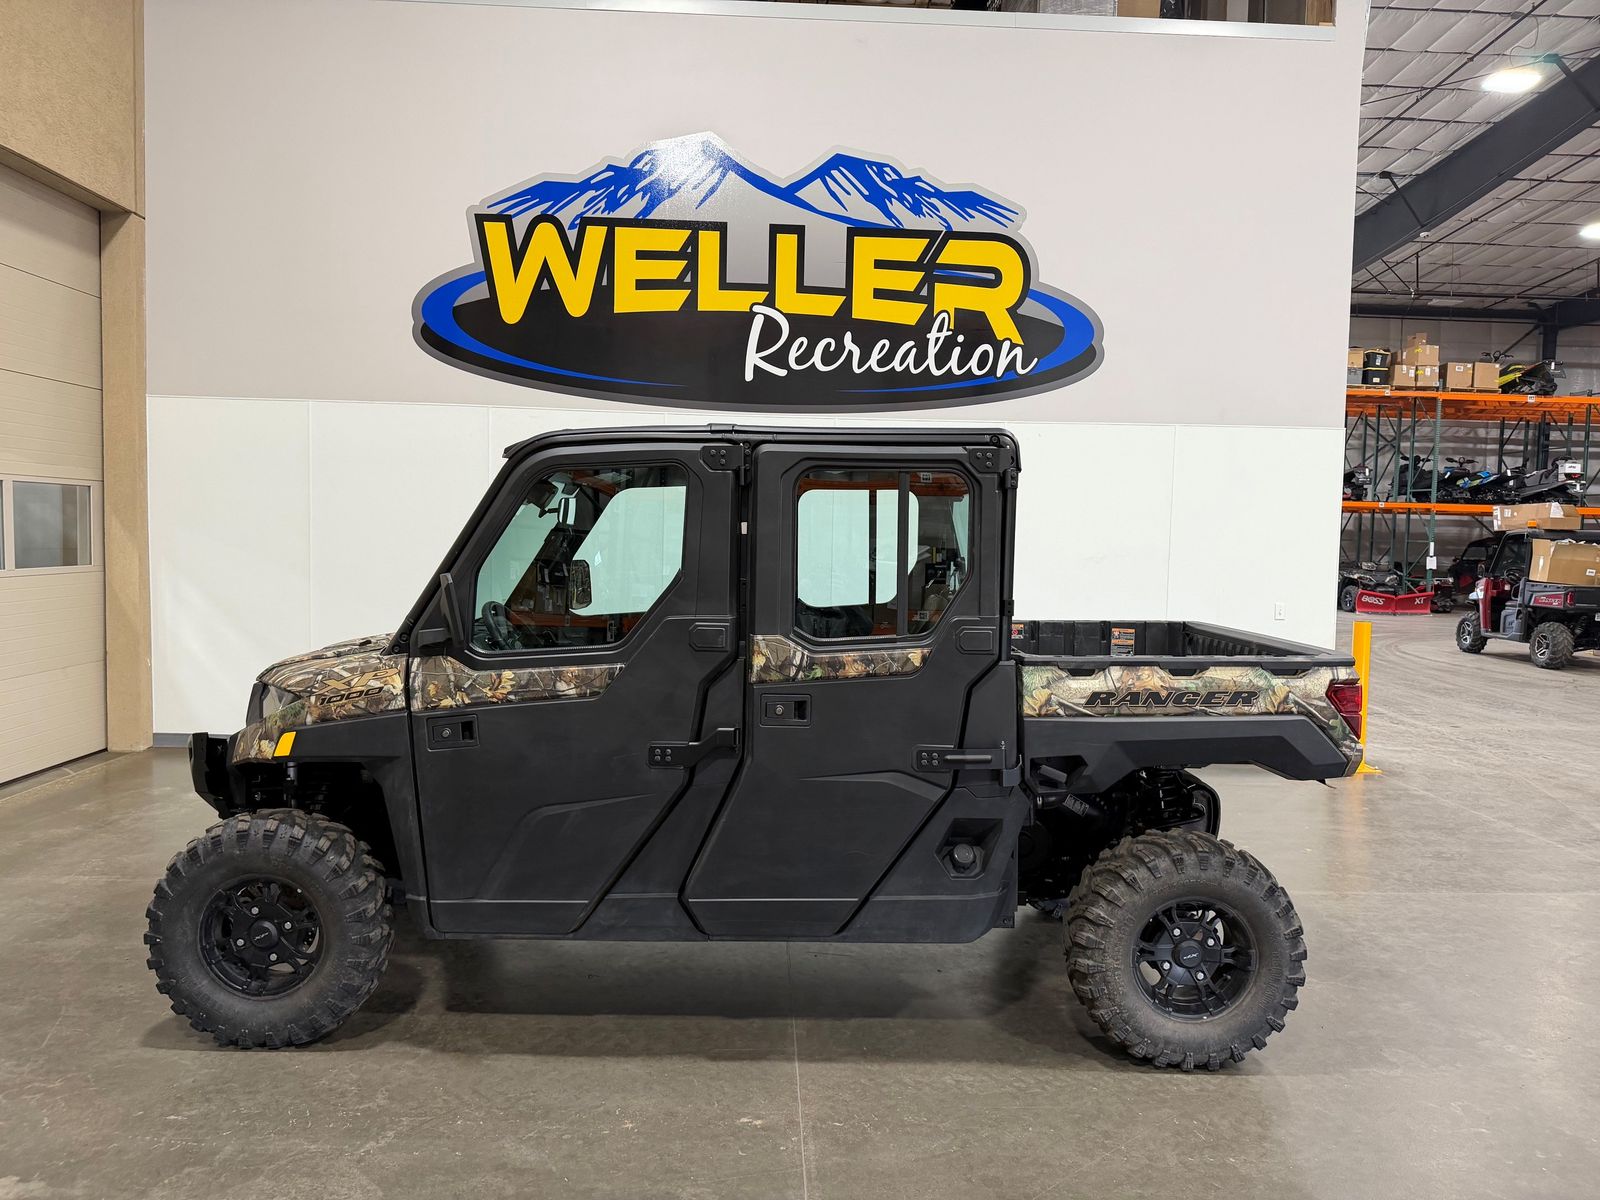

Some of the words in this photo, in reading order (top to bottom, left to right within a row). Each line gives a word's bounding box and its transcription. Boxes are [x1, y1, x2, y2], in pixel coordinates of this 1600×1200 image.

[482, 221, 1025, 346] WELLER
[744, 304, 1038, 382] Recreation
[1361, 595, 1386, 605] BOSS
[1414, 597, 1427, 605] XT
[320, 686, 384, 705] 1000
[1083, 690, 1260, 708] RANGER
